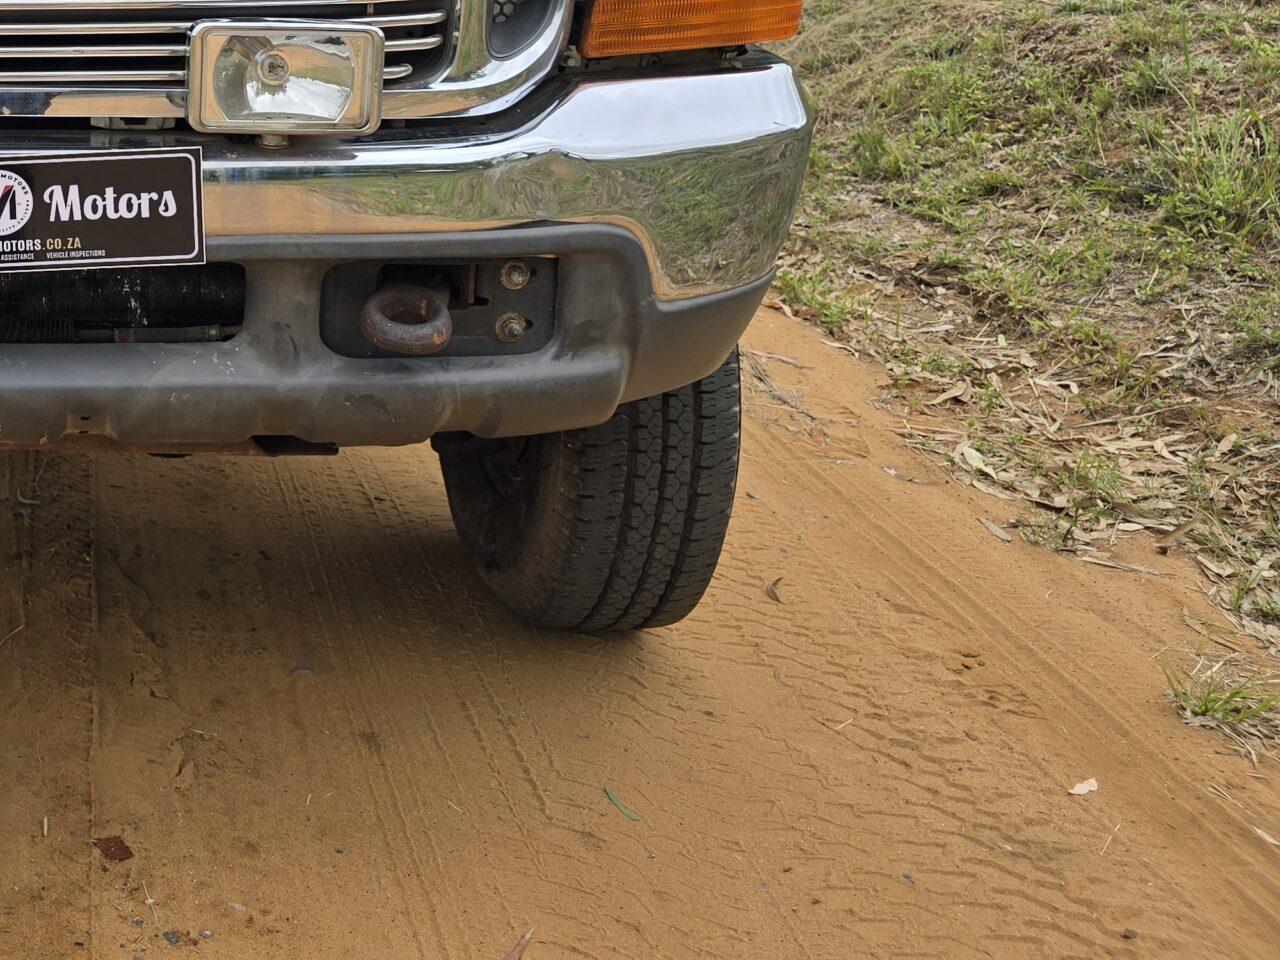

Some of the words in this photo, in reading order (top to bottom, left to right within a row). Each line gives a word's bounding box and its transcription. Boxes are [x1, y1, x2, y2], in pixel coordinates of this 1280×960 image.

[1, 173, 29, 195] MOTORS
[43, 184, 177, 223] Motors
[0, 252, 35, 261] ASSISTANCE
[46, 250, 69, 259] VEHICLE
[69, 249, 106, 258] INSPECTIONS
